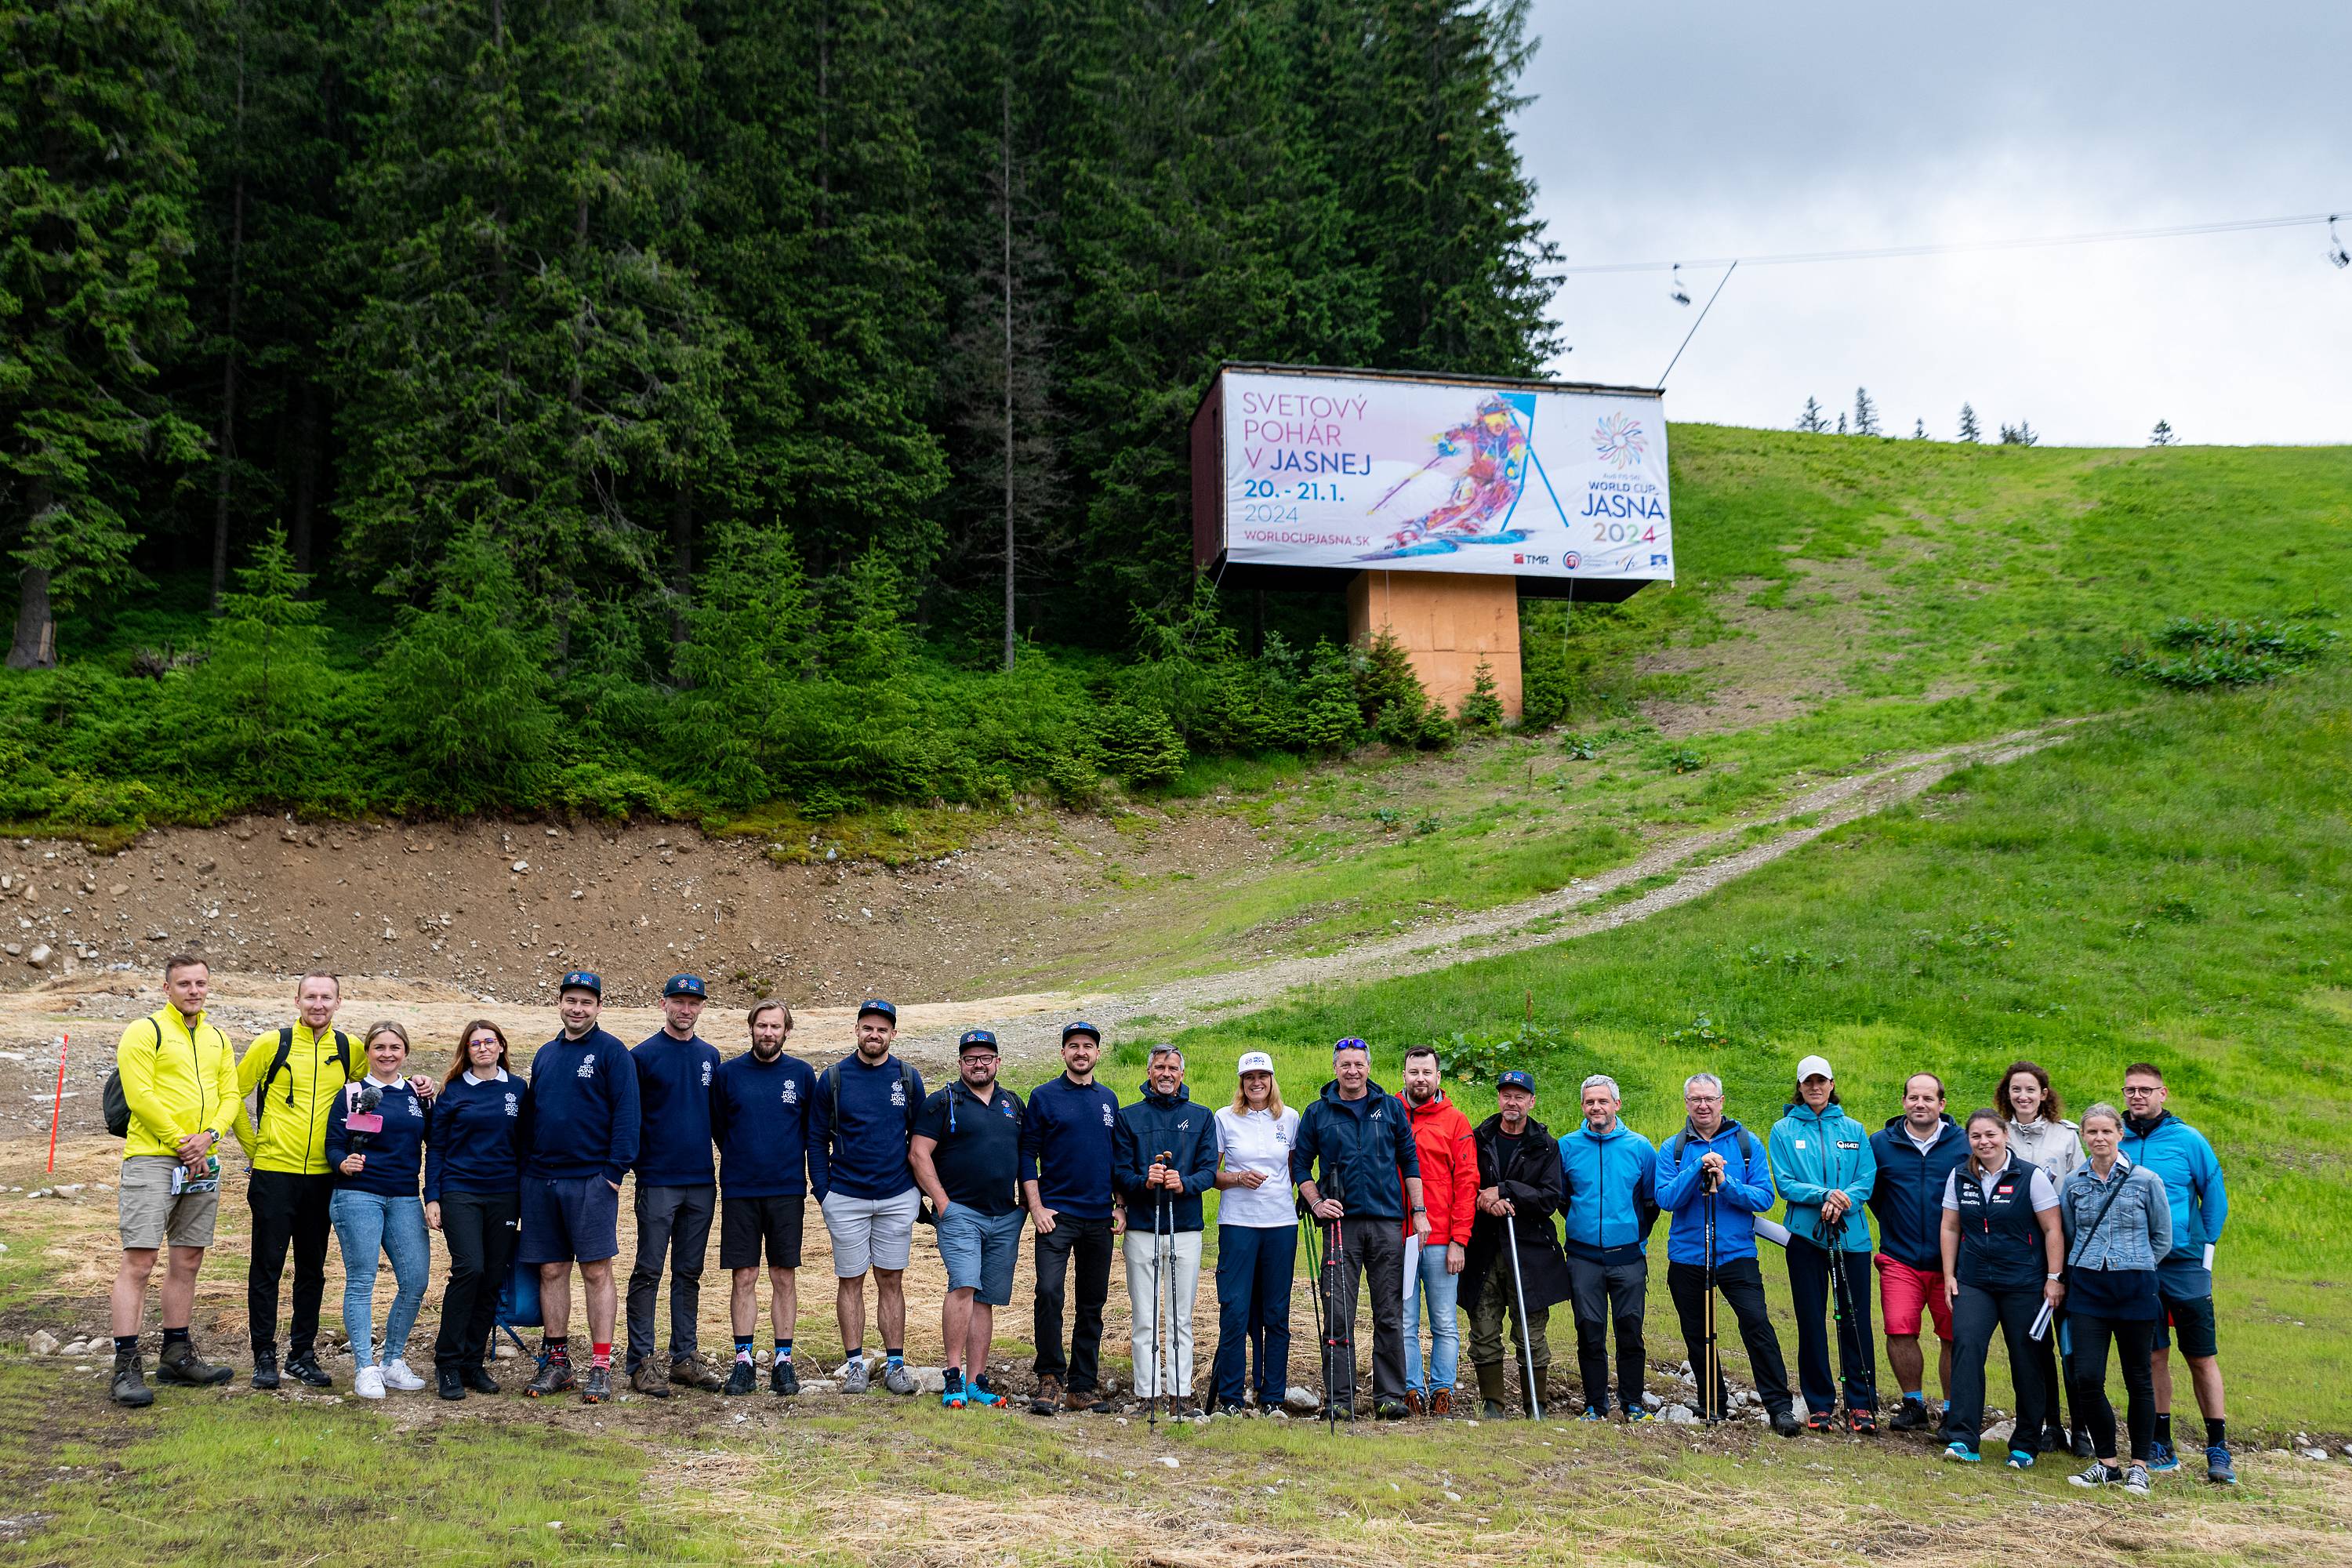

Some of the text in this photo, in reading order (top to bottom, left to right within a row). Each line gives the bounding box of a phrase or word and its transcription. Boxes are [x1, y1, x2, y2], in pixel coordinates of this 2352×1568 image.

[1243, 391, 1367, 420] SVETOVÝ
[1244, 418, 1341, 447] POHÁR
[1244, 447, 1370, 476] V JASNEJ
[1588, 481, 1656, 493] WORLD CUP
[1244, 503, 1298, 524] 2024
[1581, 492, 1664, 519] JASNÁ
[1244, 529, 1370, 546] WORLDCUPJASNA.SK
[1593, 522, 1656, 543] 2024
[1526, 554, 1549, 564] TMR
